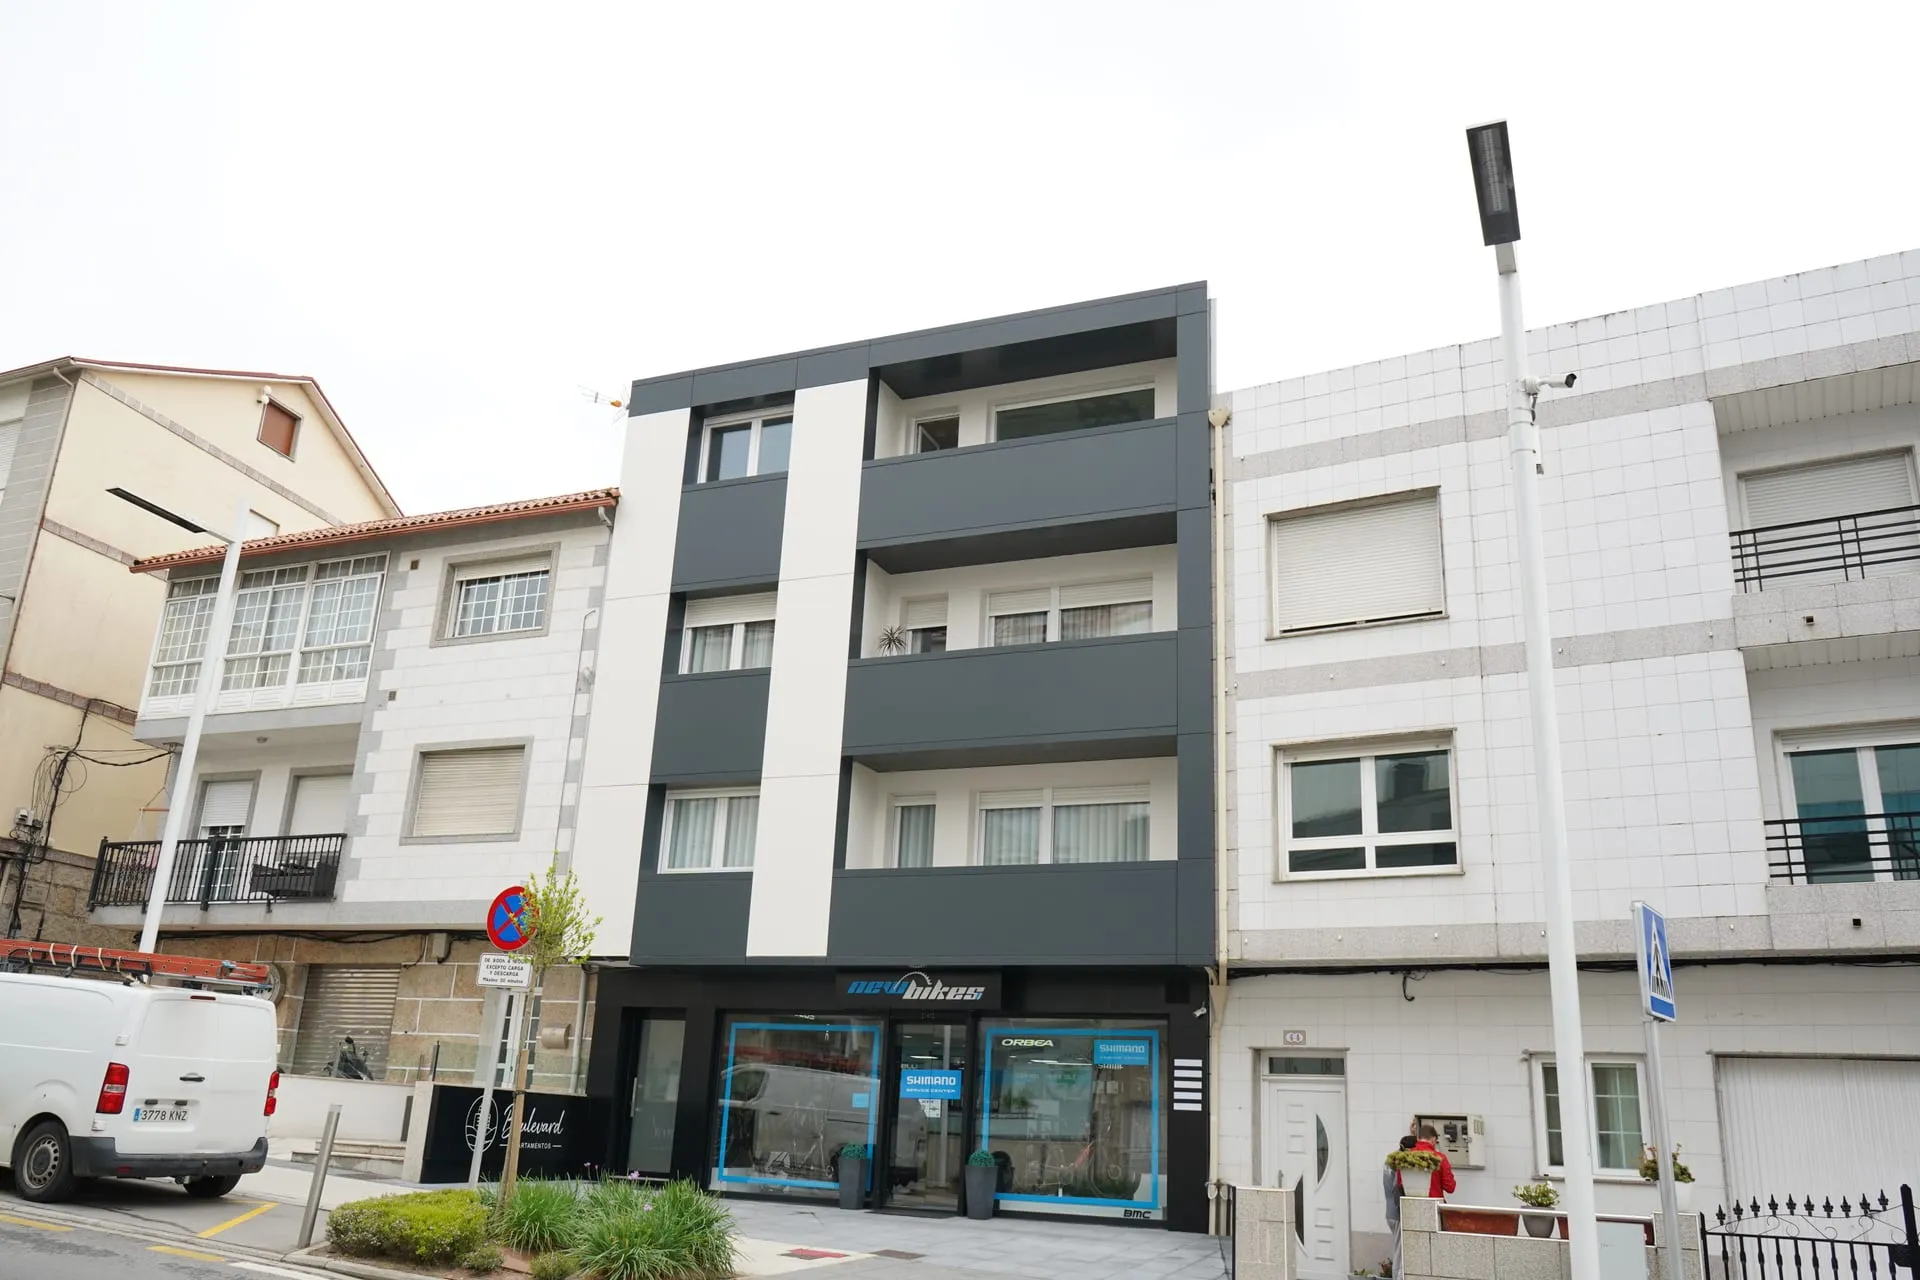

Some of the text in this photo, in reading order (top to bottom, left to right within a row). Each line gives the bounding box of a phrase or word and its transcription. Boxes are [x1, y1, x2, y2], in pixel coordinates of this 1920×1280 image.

[1001, 1038, 1054, 1047] ORBEA
[1100, 1044, 1145, 1054] SHIMANO
[906, 1075, 957, 1086] SHIMANO
[141, 1110, 188, 1121] 3778 KNZ
[501, 1103, 565, 1139] Bulevard
[1123, 1209, 1152, 1219] BMC
